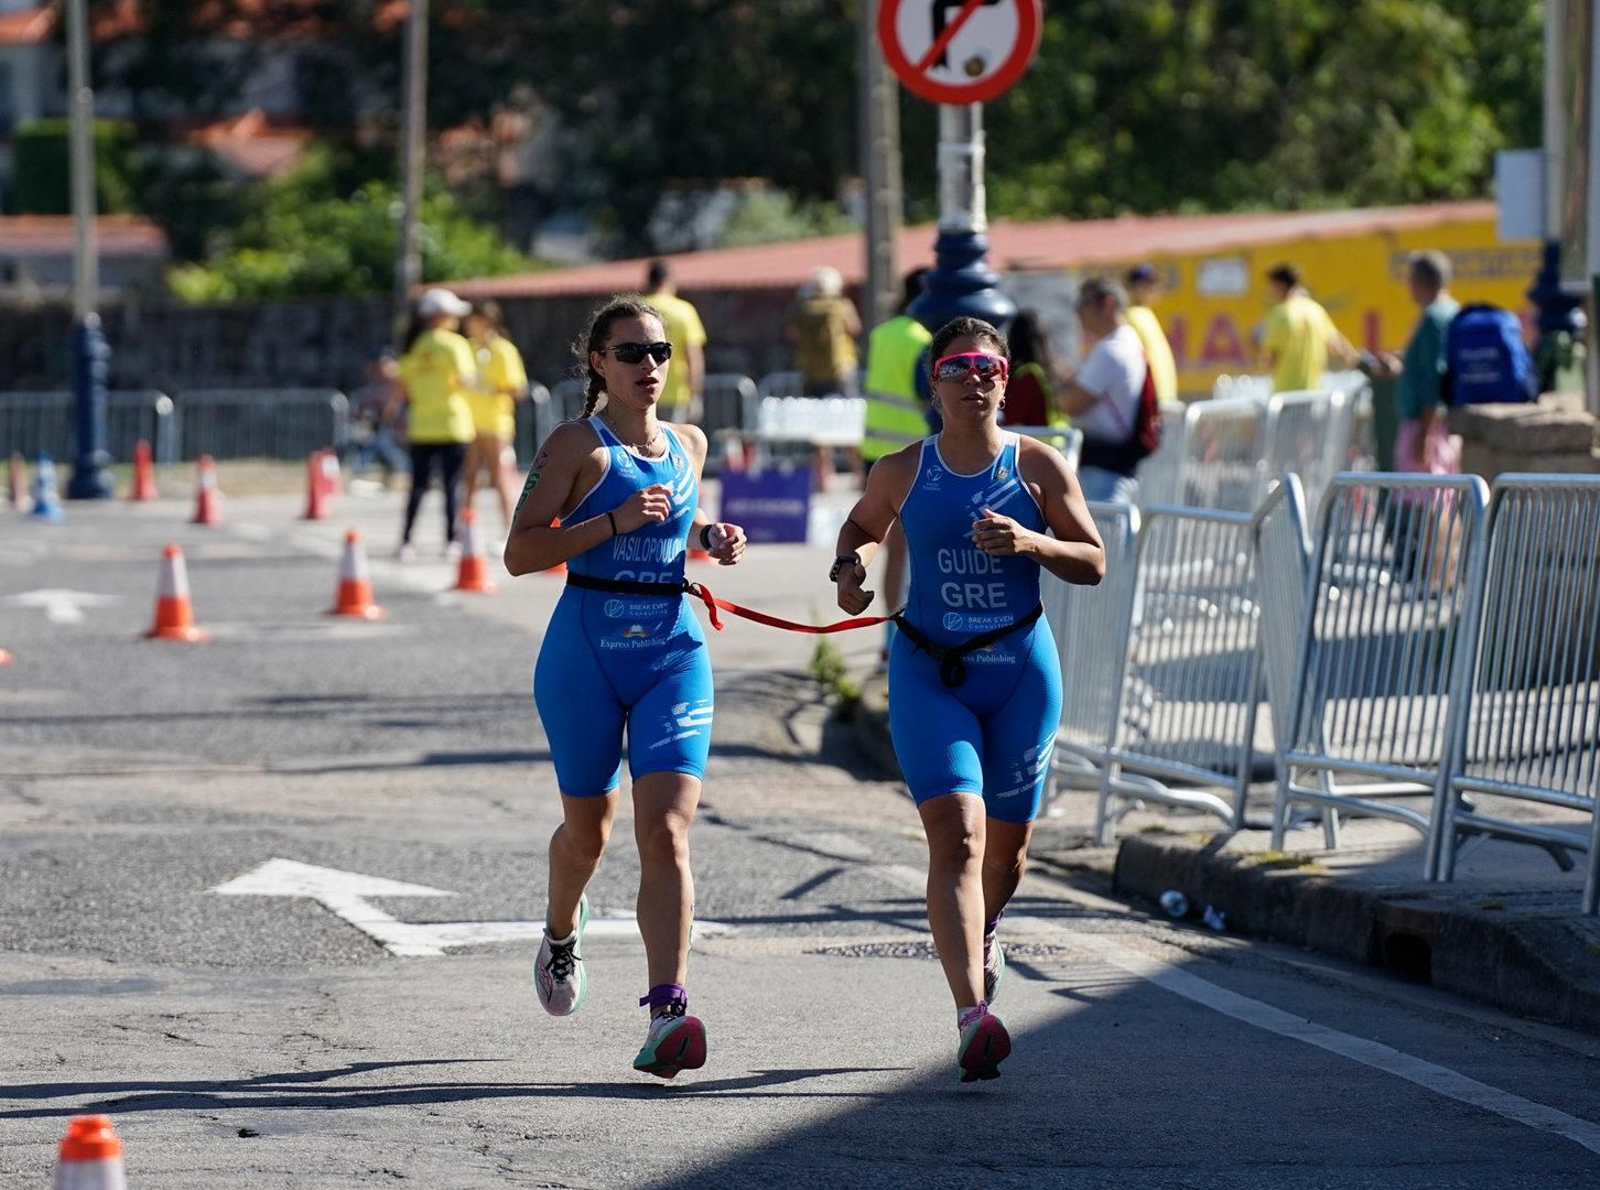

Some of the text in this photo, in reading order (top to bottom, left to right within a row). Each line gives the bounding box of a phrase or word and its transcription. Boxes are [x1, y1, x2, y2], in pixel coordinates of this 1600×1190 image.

[938, 548, 1003, 574] GUIDE
[941, 582, 1007, 609] GRE
[994, 615, 1014, 623] EVEN
[600, 639, 630, 650] Express
[976, 653, 1016, 664] Publishing
